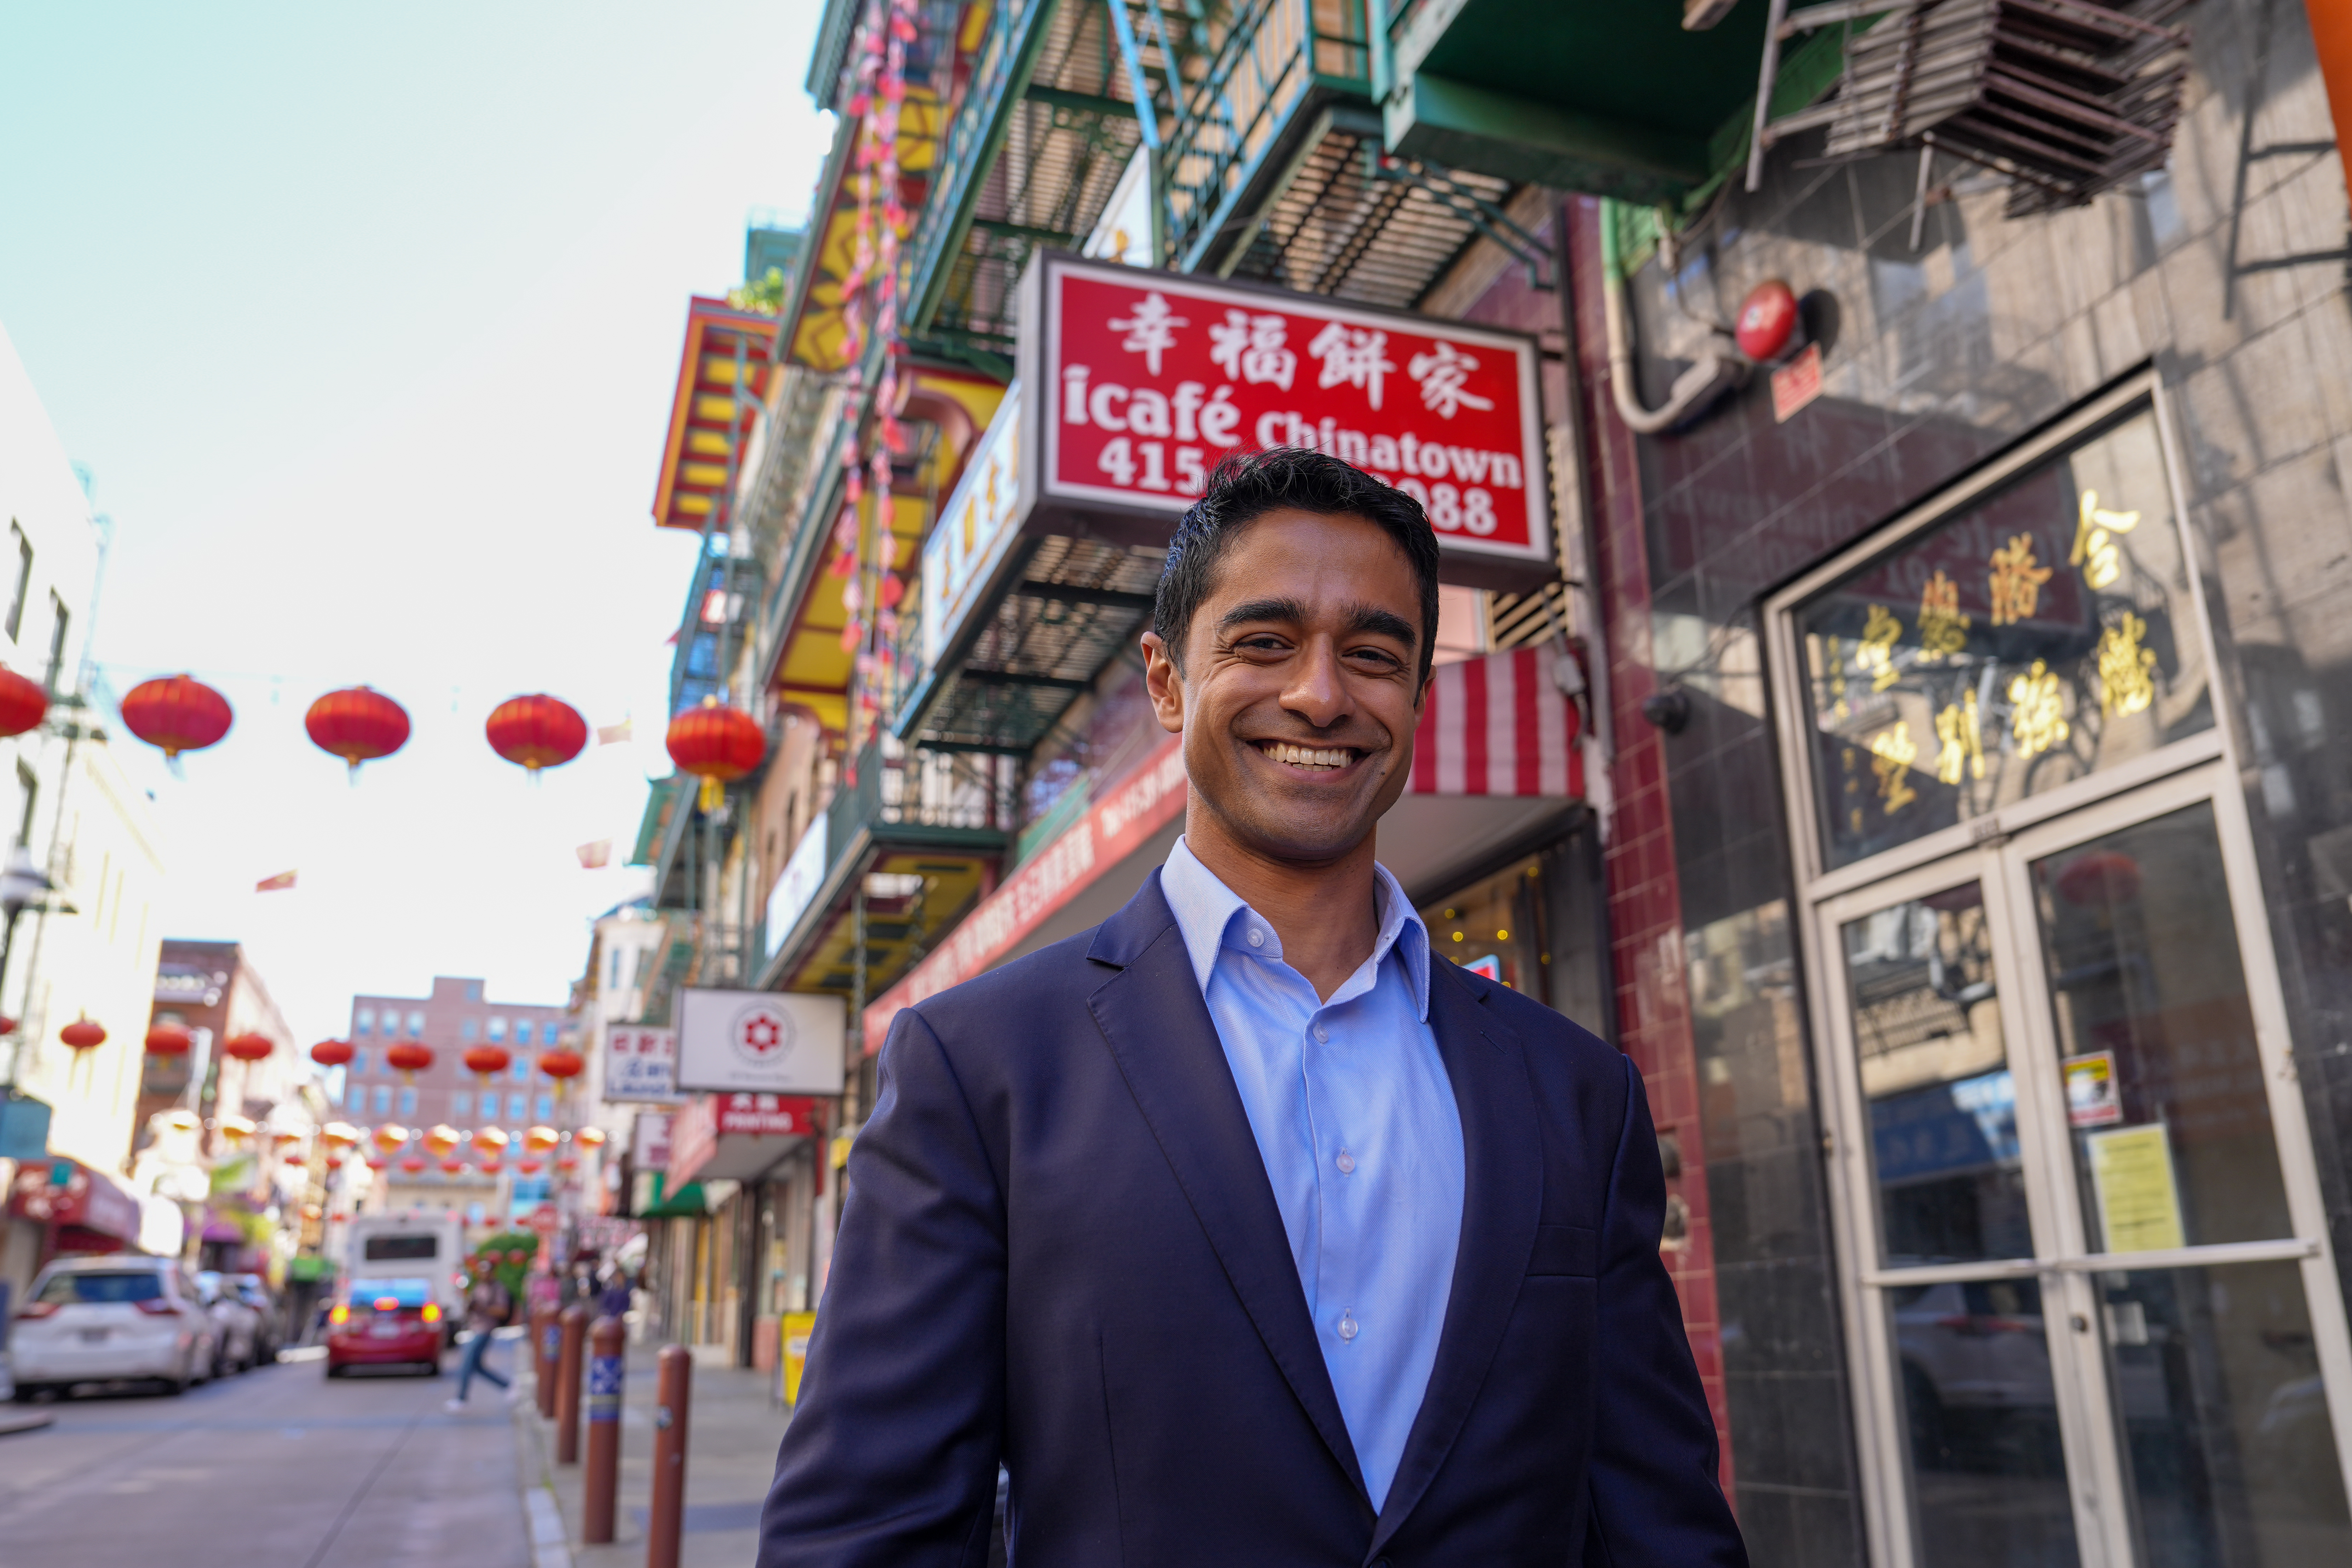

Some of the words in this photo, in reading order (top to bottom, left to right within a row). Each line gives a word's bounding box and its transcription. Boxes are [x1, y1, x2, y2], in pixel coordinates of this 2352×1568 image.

[1107, 292, 1494, 420] 幸福餅家
[1097, 436, 1205, 496] 415
[1255, 410, 1523, 490] Chinatown
